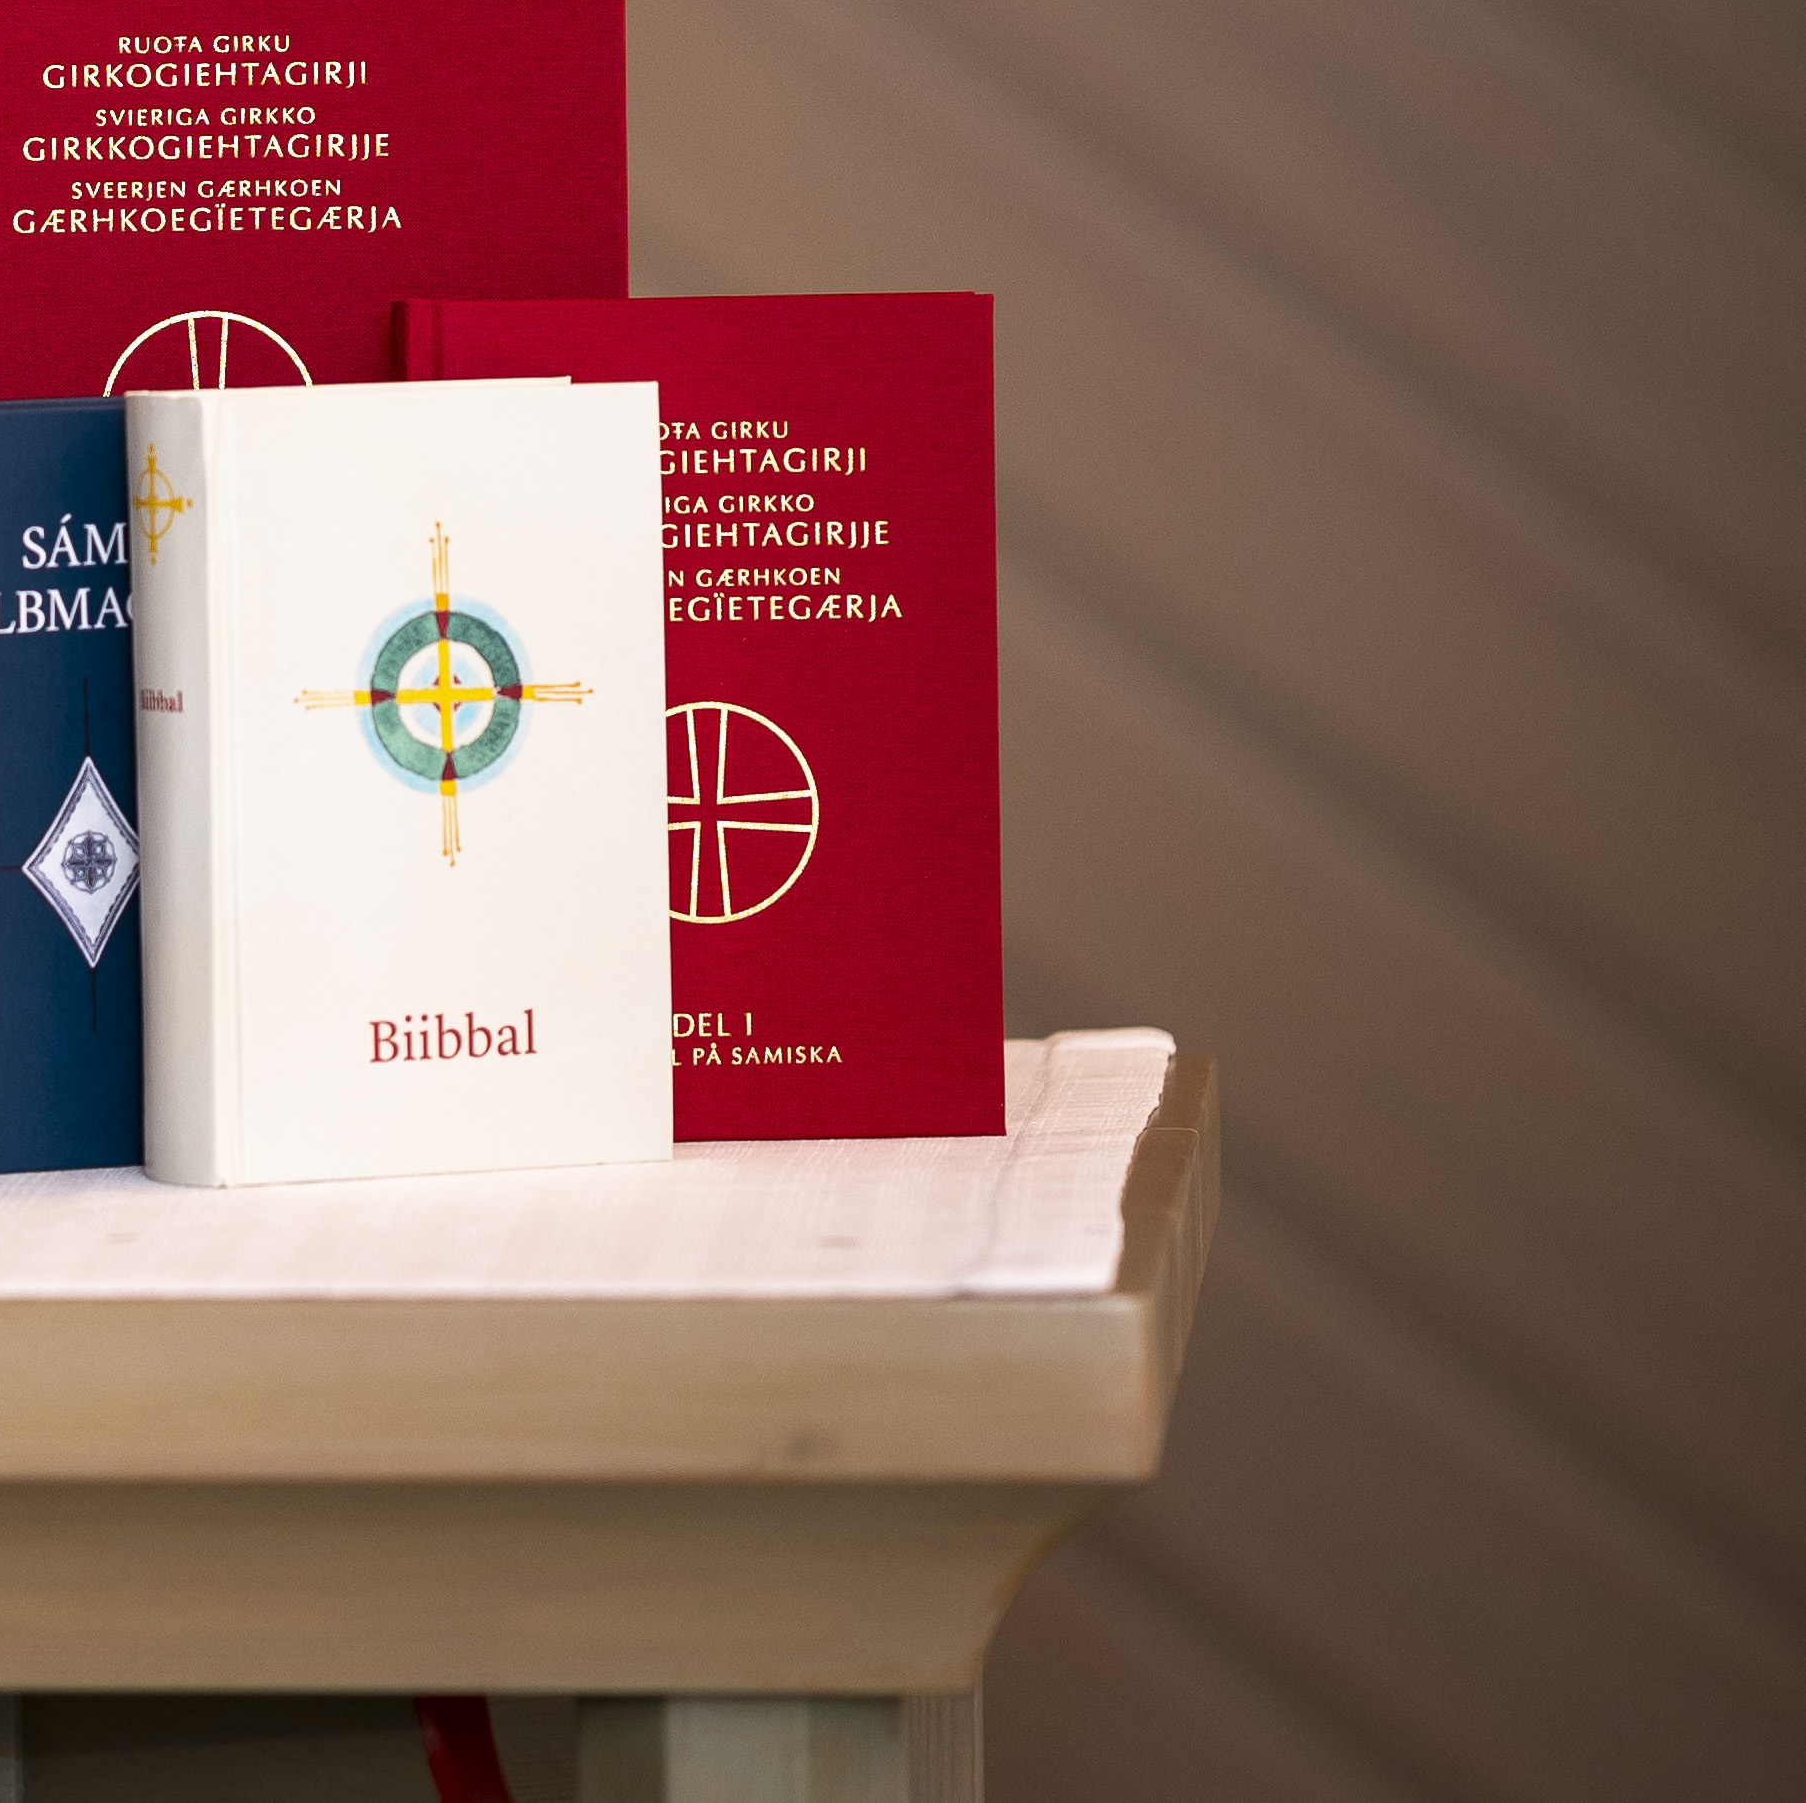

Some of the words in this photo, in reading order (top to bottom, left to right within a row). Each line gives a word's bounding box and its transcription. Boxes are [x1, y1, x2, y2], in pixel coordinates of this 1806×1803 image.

[212, 34, 290, 54] GIRKU
[42, 60, 366, 89] GIRKOGIEHTAGIRJI
[95, 107, 210, 127] SVIERIGA
[220, 106, 316, 126] GIRKKO
[22, 133, 389, 162] GIRKKOGIEHTAGIRJJE
[71, 180, 186, 202] SVEERJEN
[197, 178, 341, 199] GÆRHKOEN
[12, 202, 402, 234] GÆRHKOEGÏETEGÆRJA
[710, 420, 788, 440] GIRKU
[718, 493, 815, 514] GIRKKO
[695, 567, 841, 588] GÆRHKOEN
[369, 1008, 537, 1063] Biibbal
[672, 1012, 732, 1038] DEL
[745, 1012, 752, 1036] I
[692, 1042, 722, 1066] PÅ
[731, 1045, 843, 1066] SAMISKA
